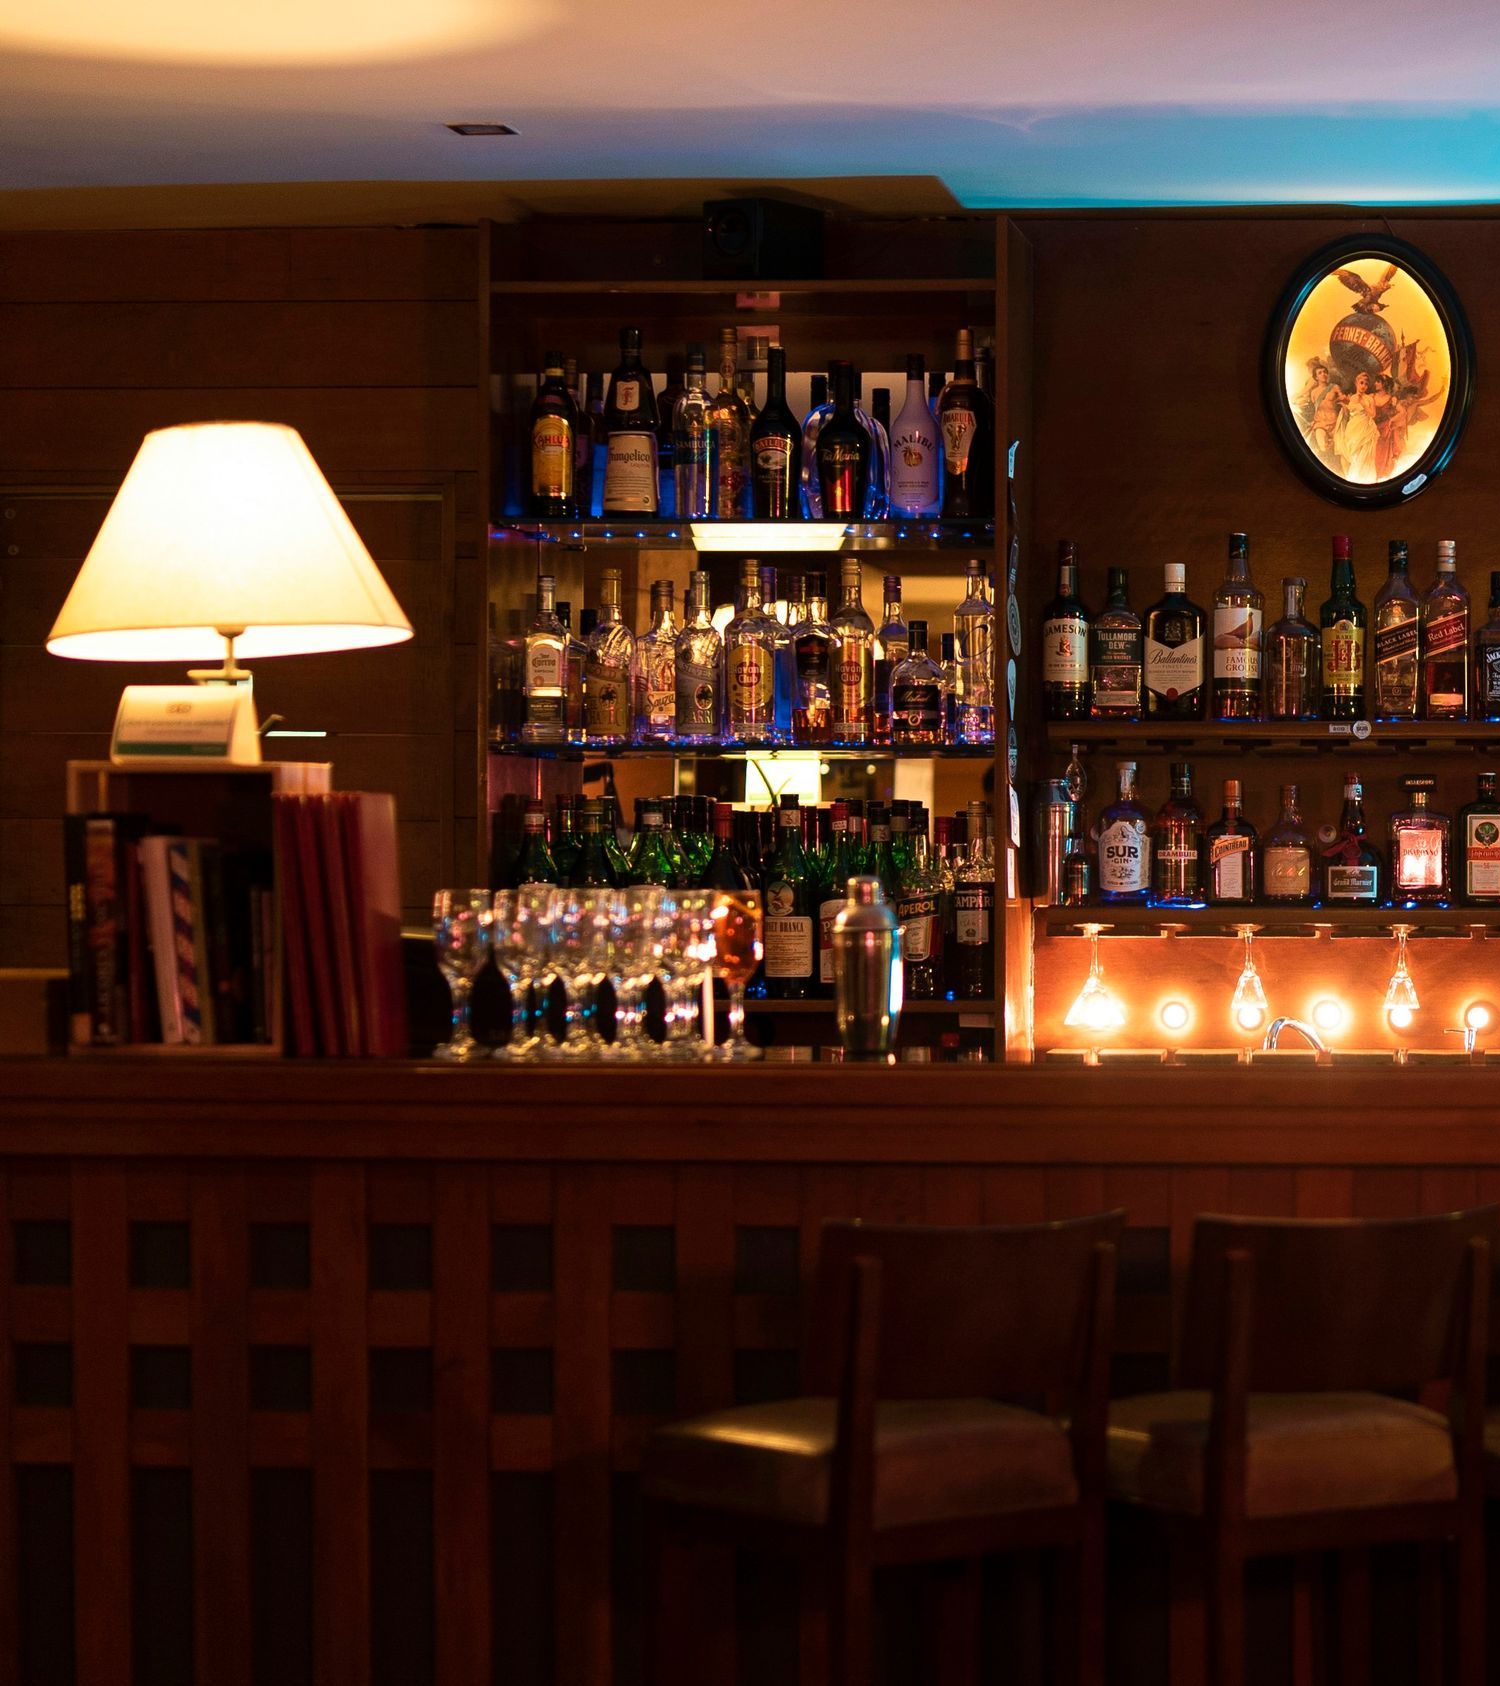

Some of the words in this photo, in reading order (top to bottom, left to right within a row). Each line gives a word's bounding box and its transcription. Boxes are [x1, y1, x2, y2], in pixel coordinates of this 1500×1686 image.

[894, 435, 935, 451] MALIBU
[1098, 630, 1138, 641] TULLAMORE
[1428, 632, 1443, 642] Red
[1444, 623, 1465, 636] Label
[1108, 641, 1126, 650] DEW
[1486, 651, 1500, 663] JACK
[738, 674, 758, 683] Club
[840, 673, 860, 682] Club
[1107, 846, 1138, 858] SUR
[1214, 840, 1248, 858] COINTREAU
[1333, 878, 1350, 886] Grand
[1350, 878, 1373, 886] Marnier
[898, 900, 936, 917] APEROL
[778, 922, 804, 933] BRANCA
